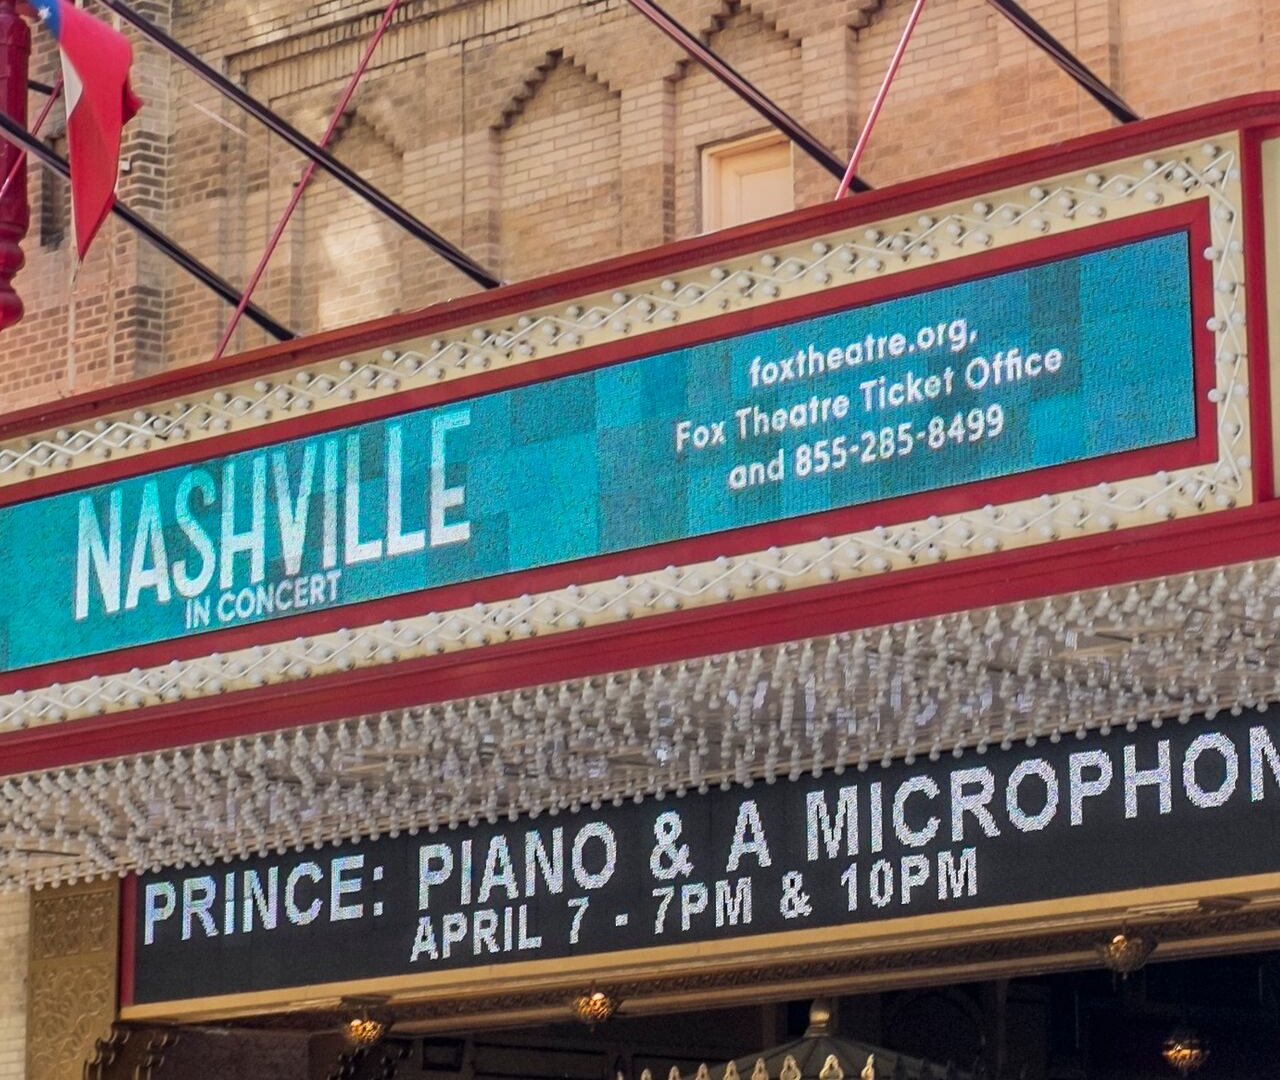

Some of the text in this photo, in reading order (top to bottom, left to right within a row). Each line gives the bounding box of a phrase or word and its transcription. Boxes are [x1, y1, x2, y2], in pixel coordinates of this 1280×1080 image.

[676, 348, 1063, 451] Fox Theatre Ticket Office
[749, 319, 978, 387] foxtheatre.org,
[729, 404, 1004, 490] and 855-285-8499
[74, 409, 471, 620] NASHVILLE
[185, 569, 342, 628] IN CONCERT
[144, 854, 384, 945] PRINCE:
[419, 821, 617, 910] PIANO
[650, 811, 694, 880] &
[726, 800, 772, 873] A
[410, 847, 978, 963] APRIL 7 - 7PM & 10PM
